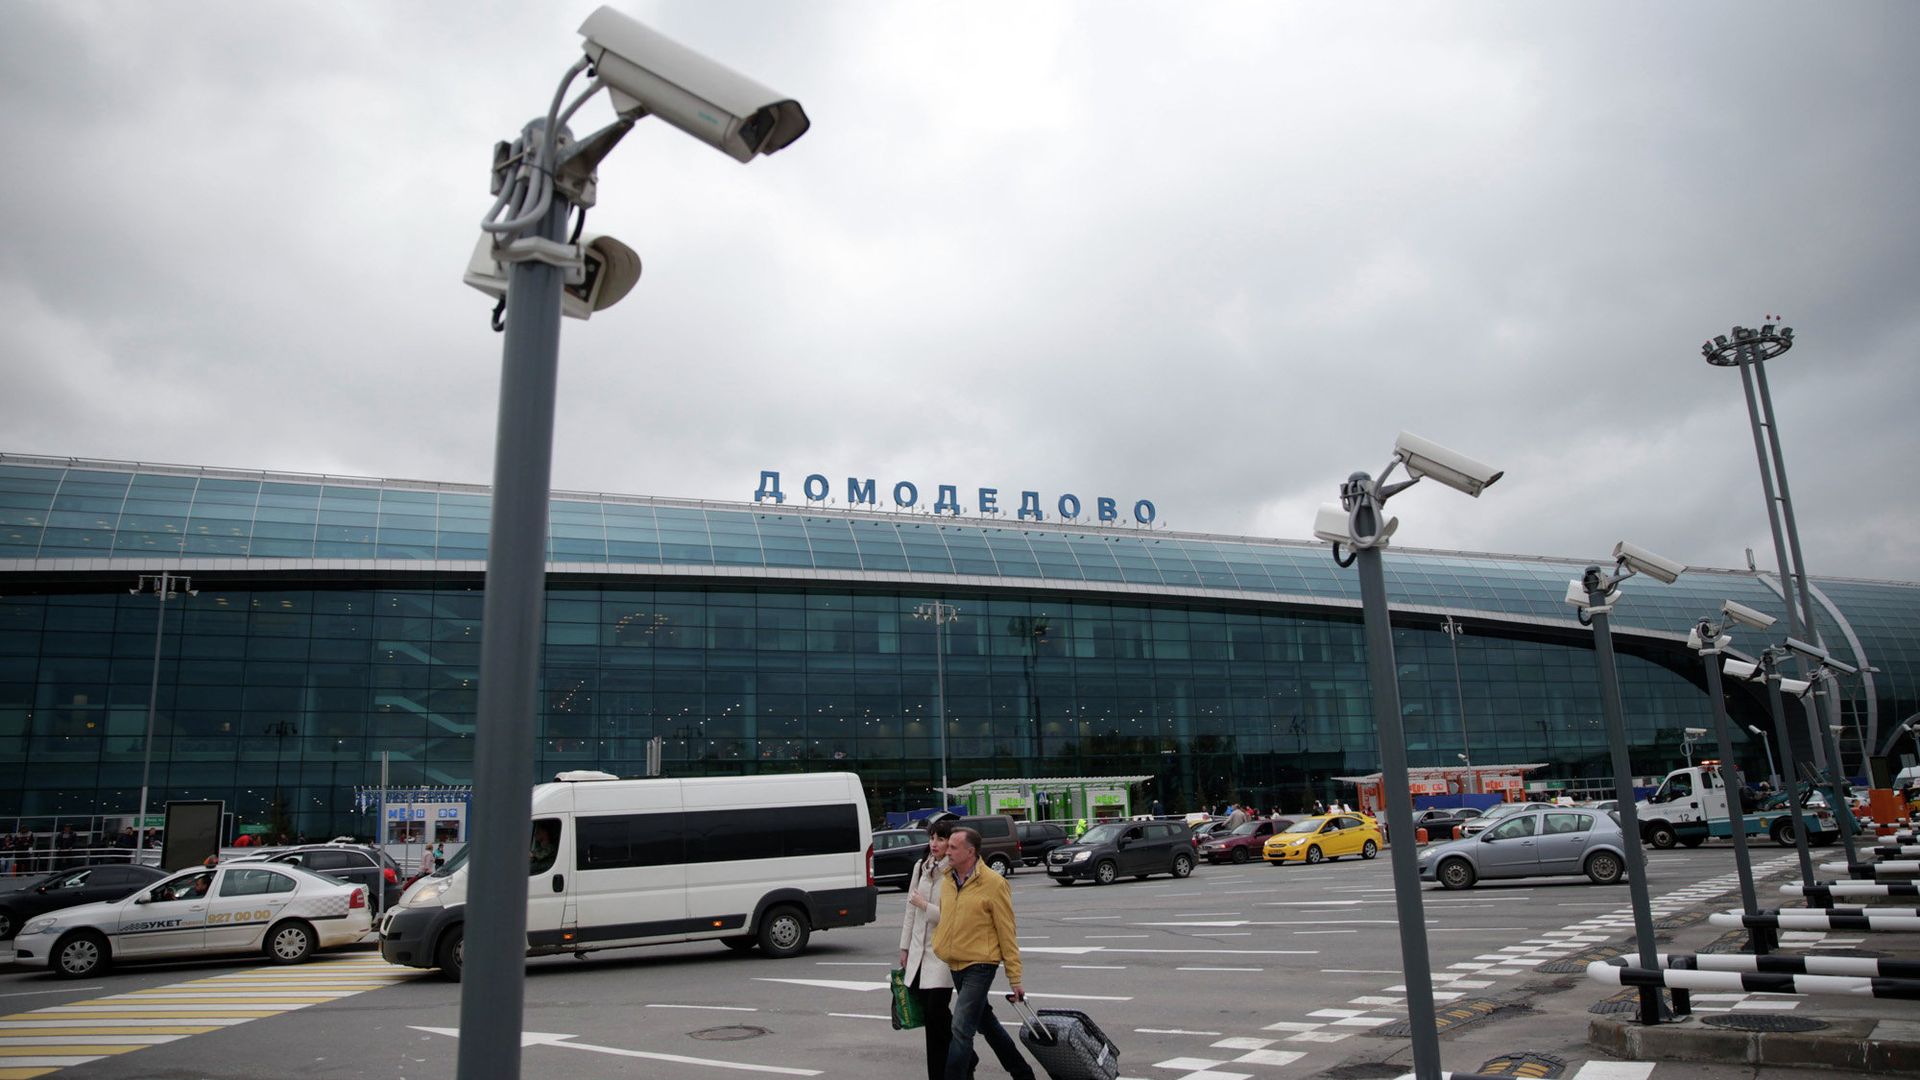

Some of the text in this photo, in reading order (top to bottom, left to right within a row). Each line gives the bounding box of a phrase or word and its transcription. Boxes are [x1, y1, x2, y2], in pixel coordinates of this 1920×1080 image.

[754, 470, 1157, 525] ДОМОДЕДОВО
[1679, 813, 1690, 822] 12
[207, 912, 231, 923] 927
